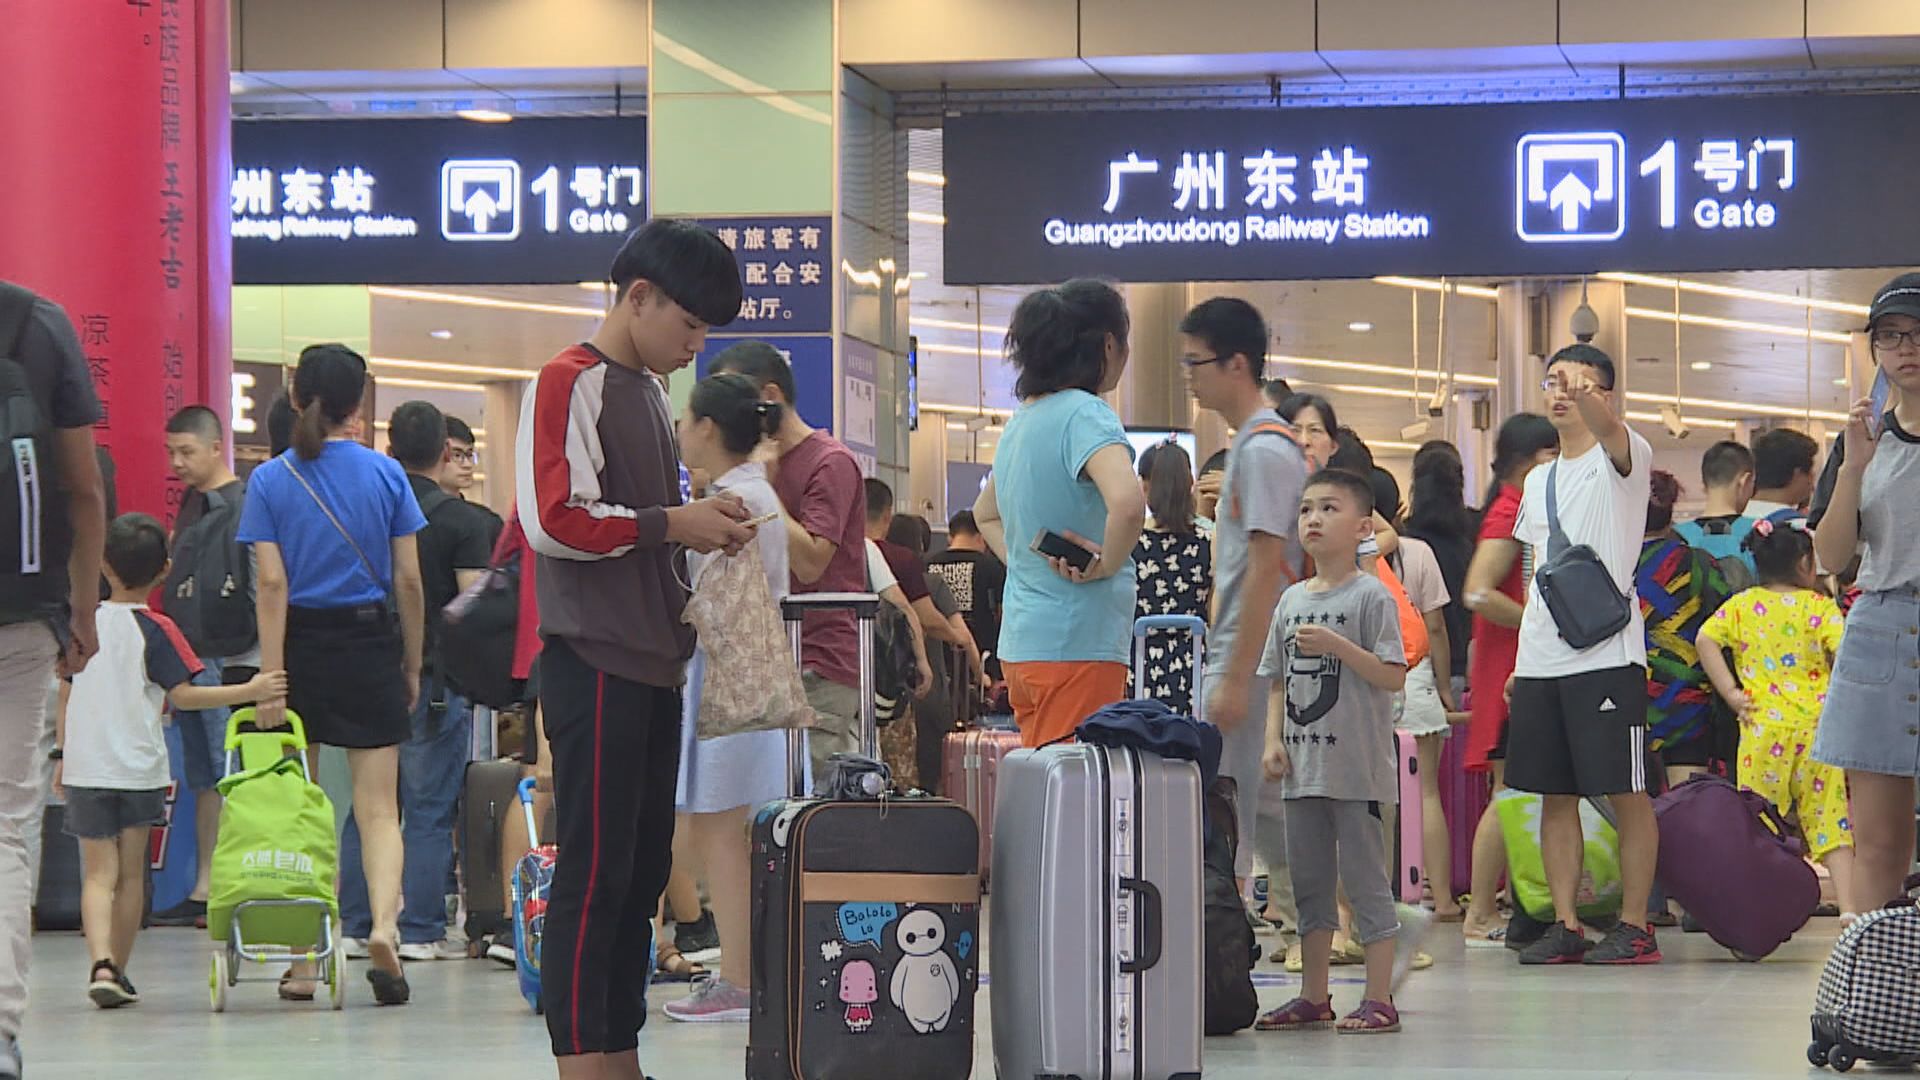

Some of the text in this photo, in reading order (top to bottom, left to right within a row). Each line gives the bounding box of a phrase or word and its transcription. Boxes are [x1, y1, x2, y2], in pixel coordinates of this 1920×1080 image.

[231, 167, 376, 214] 州东站
[531, 165, 641, 233] 1 号门
[1103, 146, 1369, 213] 广州东站
[1640, 137, 1794, 228] 1 号门
[569, 208, 628, 233] Gate
[1044, 211, 1429, 249] Guangzhoudong Railway Station
[1694, 198, 1776, 229] Gate
[745, 261, 820, 285] 配合安
